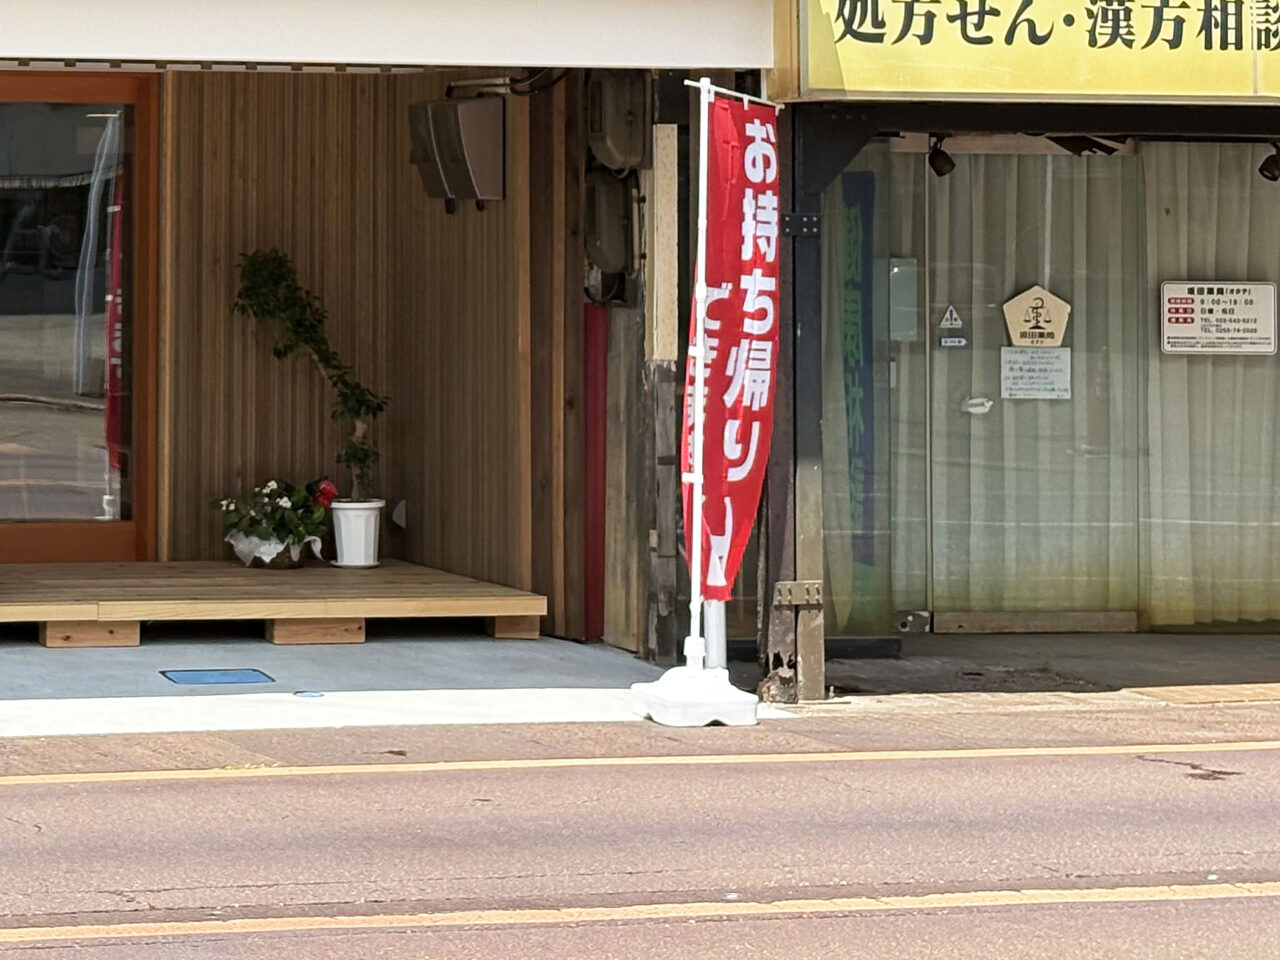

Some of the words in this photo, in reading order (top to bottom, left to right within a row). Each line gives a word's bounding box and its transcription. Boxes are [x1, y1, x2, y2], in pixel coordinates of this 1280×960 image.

[723, 118, 779, 482] お持ち帰り
